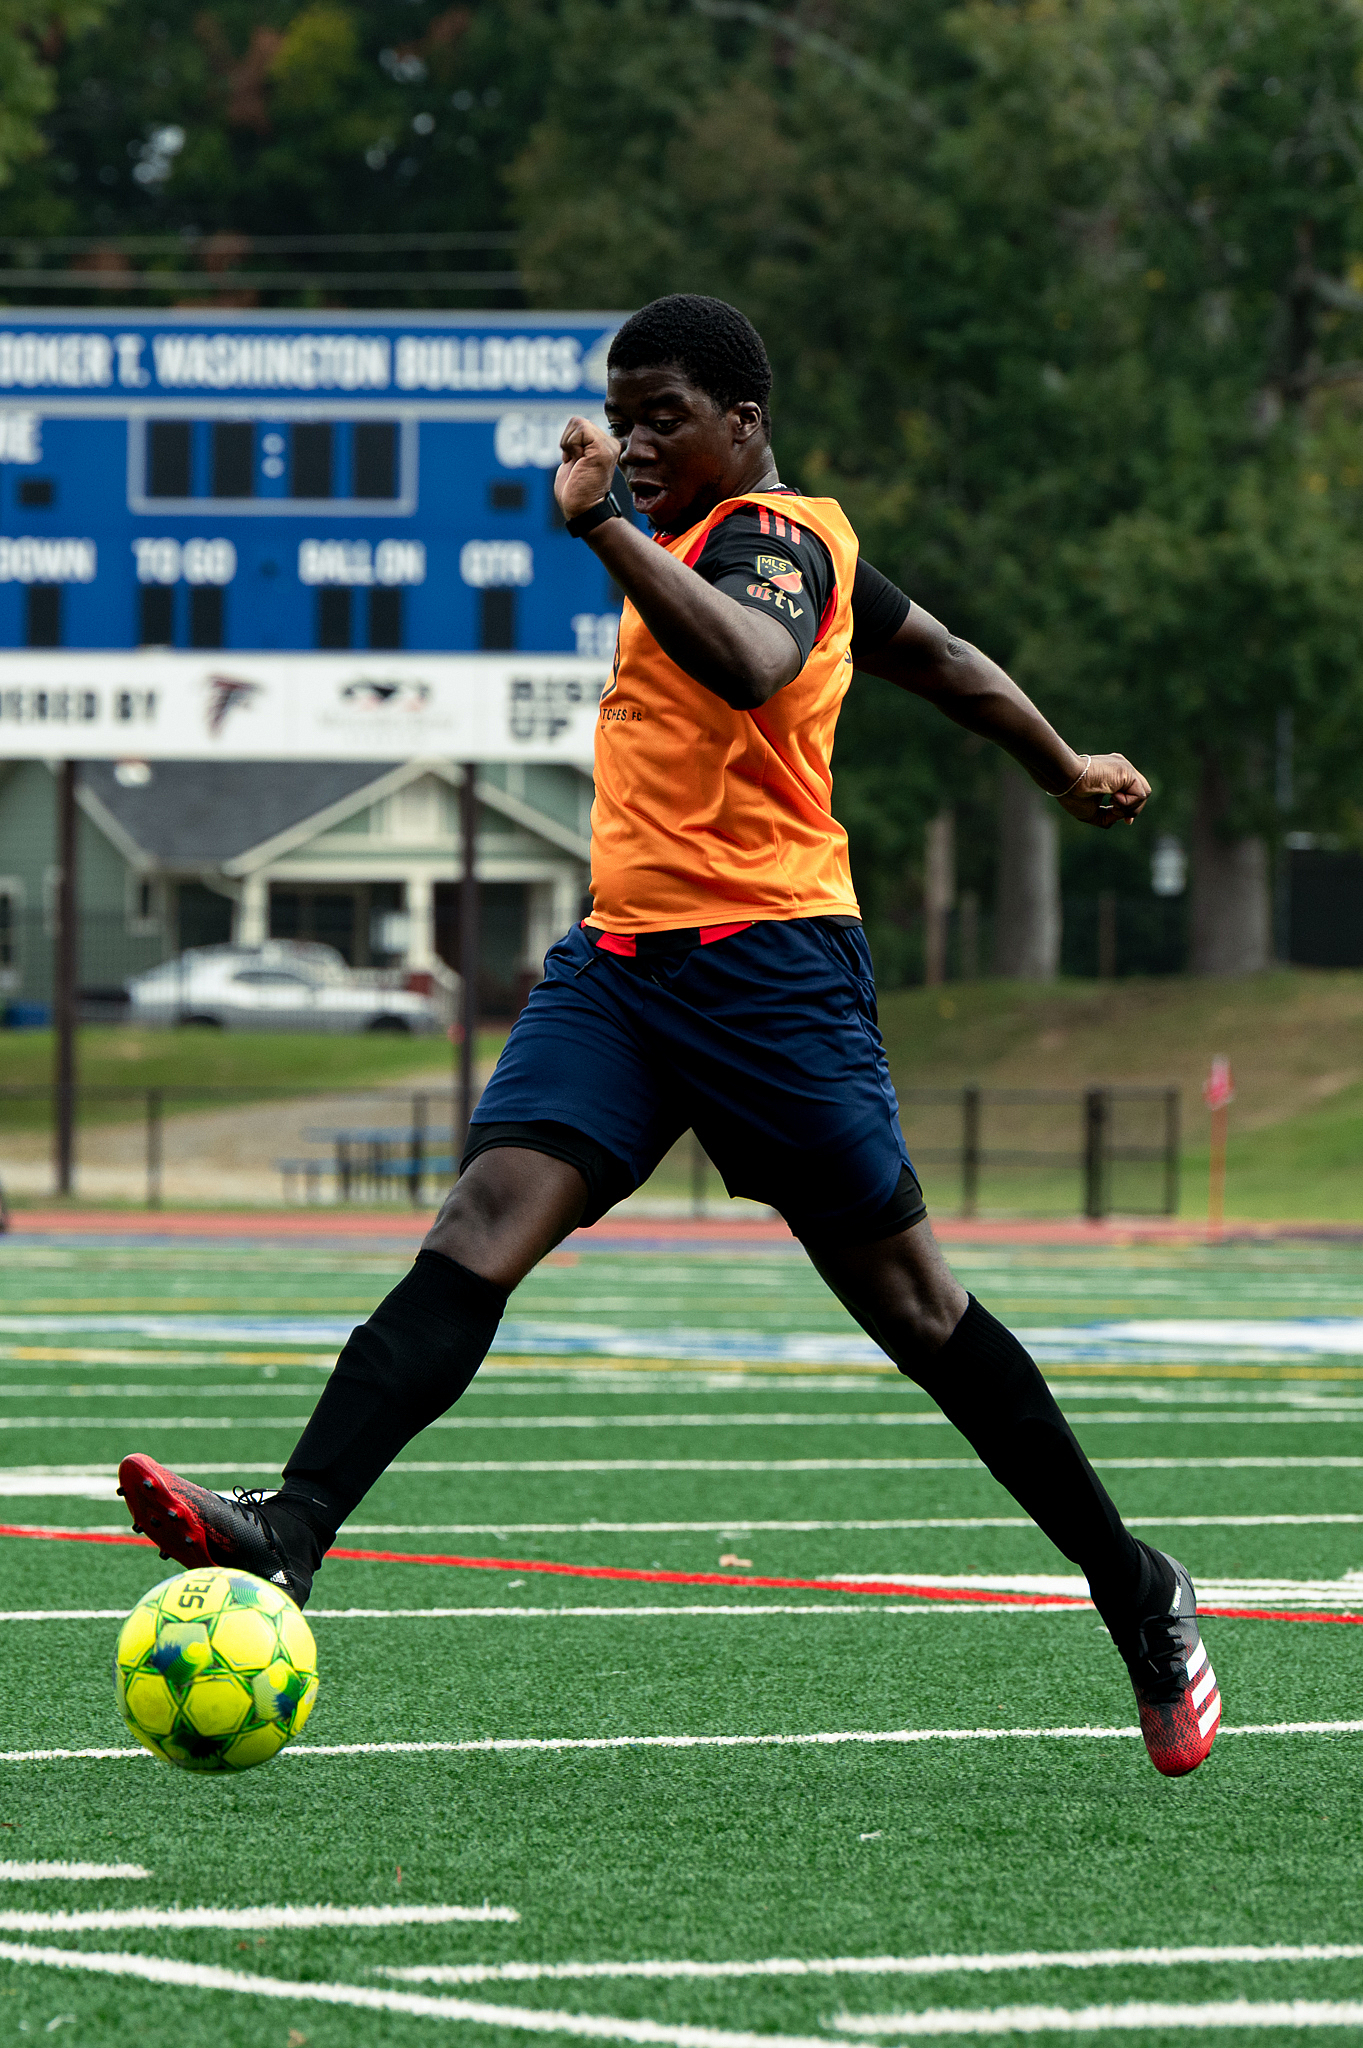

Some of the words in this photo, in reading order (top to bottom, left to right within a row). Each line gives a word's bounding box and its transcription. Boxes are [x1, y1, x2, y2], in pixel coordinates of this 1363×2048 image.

[152, 334, 391, 390] WASHINGTON
[395, 335, 583, 391] BULLDOGS
[131, 537, 180, 584] TO
[182, 537, 238, 585] GO
[298, 538, 373, 586] BALL
[375, 538, 427, 586] ON
[460, 539, 534, 588] QTR
[761, 557, 787, 572] MLS
[774, 589, 804, 619] tv
[0, 686, 98, 721] ERED
[114, 685, 162, 721] BY
[600, 708, 628, 721] TCHES
[631, 711, 643, 721] FC
